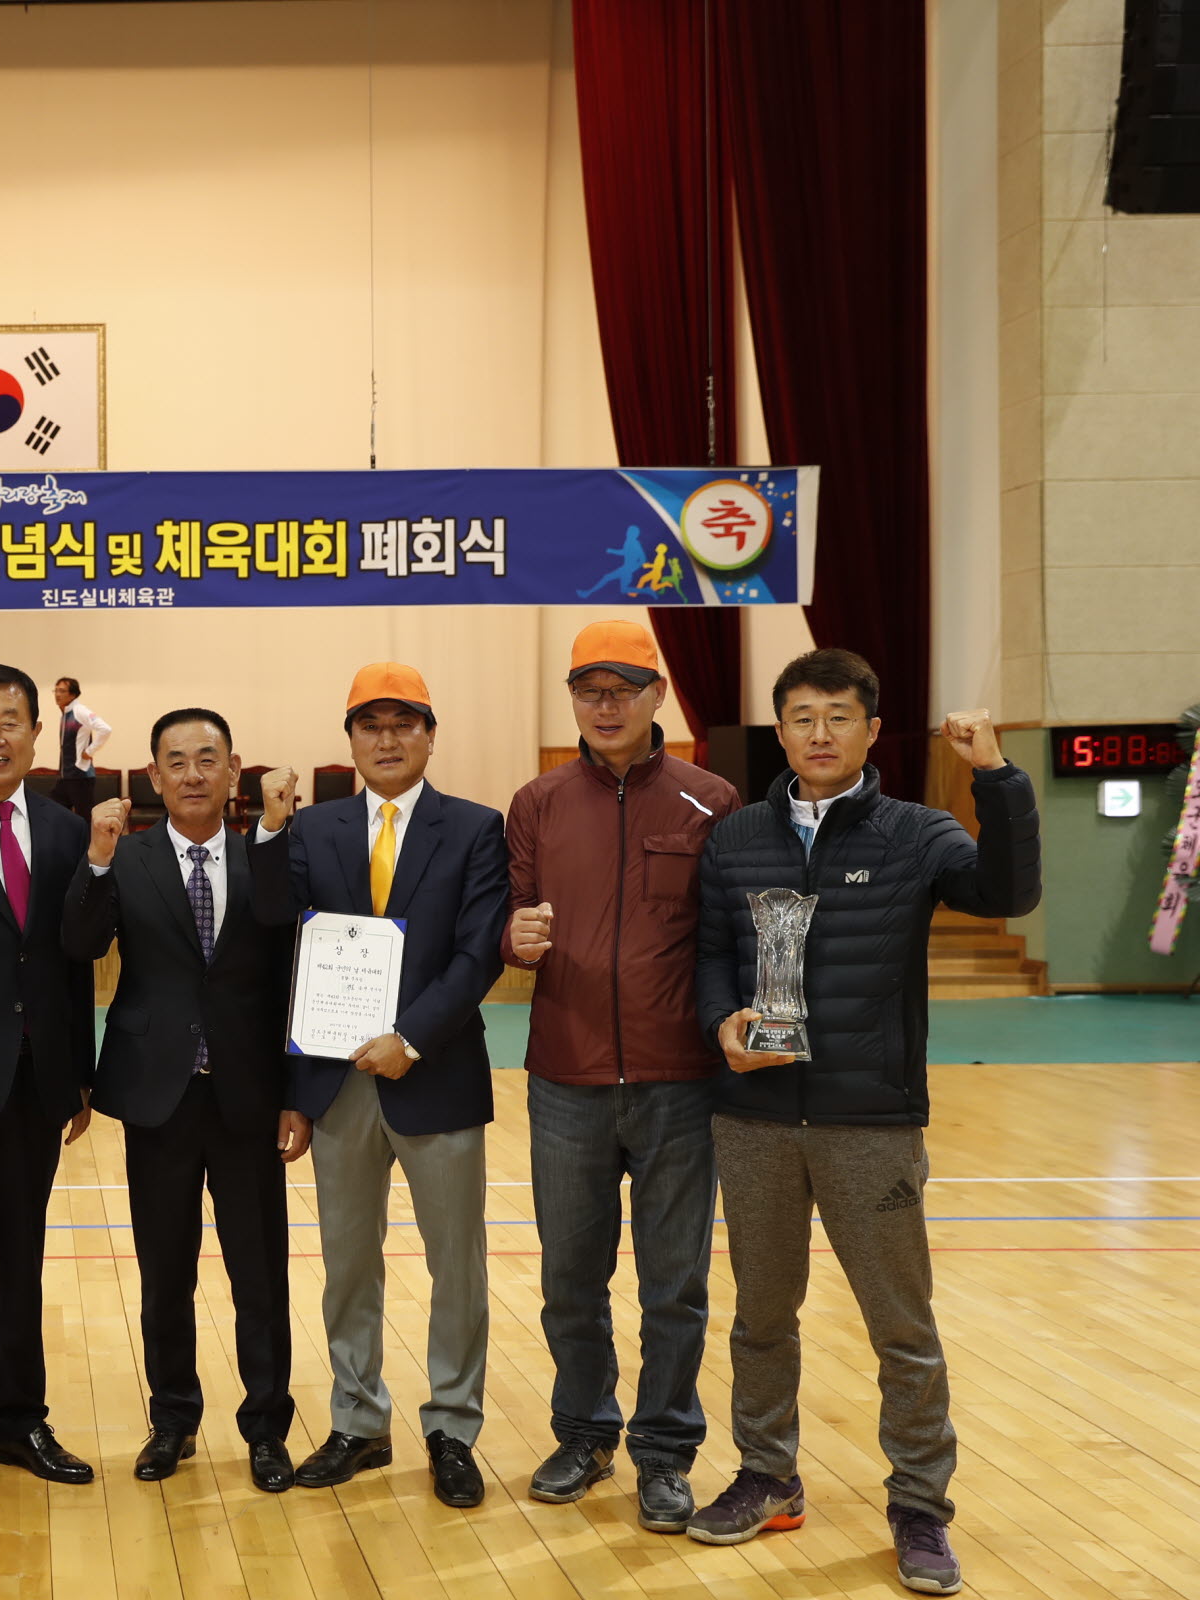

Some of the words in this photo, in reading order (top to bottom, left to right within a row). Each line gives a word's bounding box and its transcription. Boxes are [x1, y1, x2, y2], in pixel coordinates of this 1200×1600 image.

[700, 499, 757, 552] 축
[109, 534, 142, 575] 및
[156, 520, 346, 577] 체육대회
[361, 518, 504, 576] 폐회식
[42, 588, 175, 607] 진도실내체육관
[876, 1194, 921, 1212] adida
